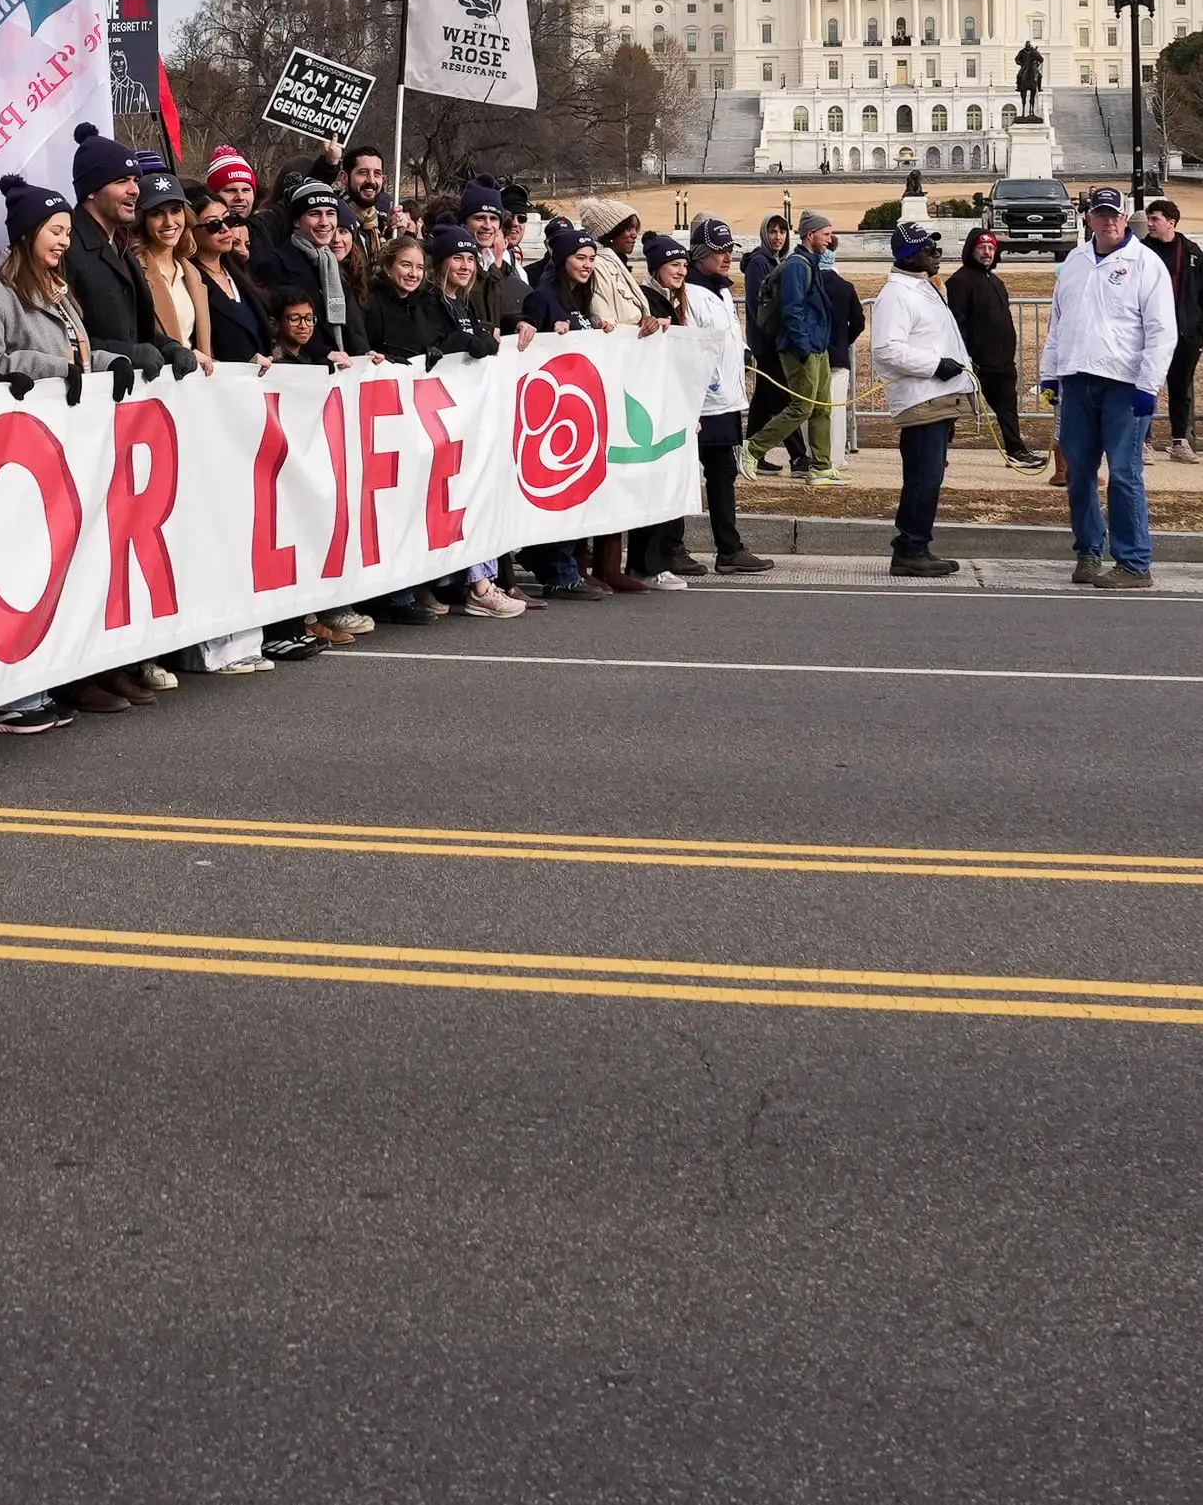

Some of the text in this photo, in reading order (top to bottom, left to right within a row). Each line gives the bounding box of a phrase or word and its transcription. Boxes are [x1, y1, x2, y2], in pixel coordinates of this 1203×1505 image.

[112, 21, 141, 33] REGRET
[442, 25, 511, 52] WHITE
[441, 61, 508, 80] RESISTANCE
[449, 45, 503, 68] ROSE
[290, 63, 363, 101] I AM THE
[277, 77, 361, 121] PRO-LIFE
[273, 97, 351, 136] GENERATION
[252, 376, 468, 594] LIFE
